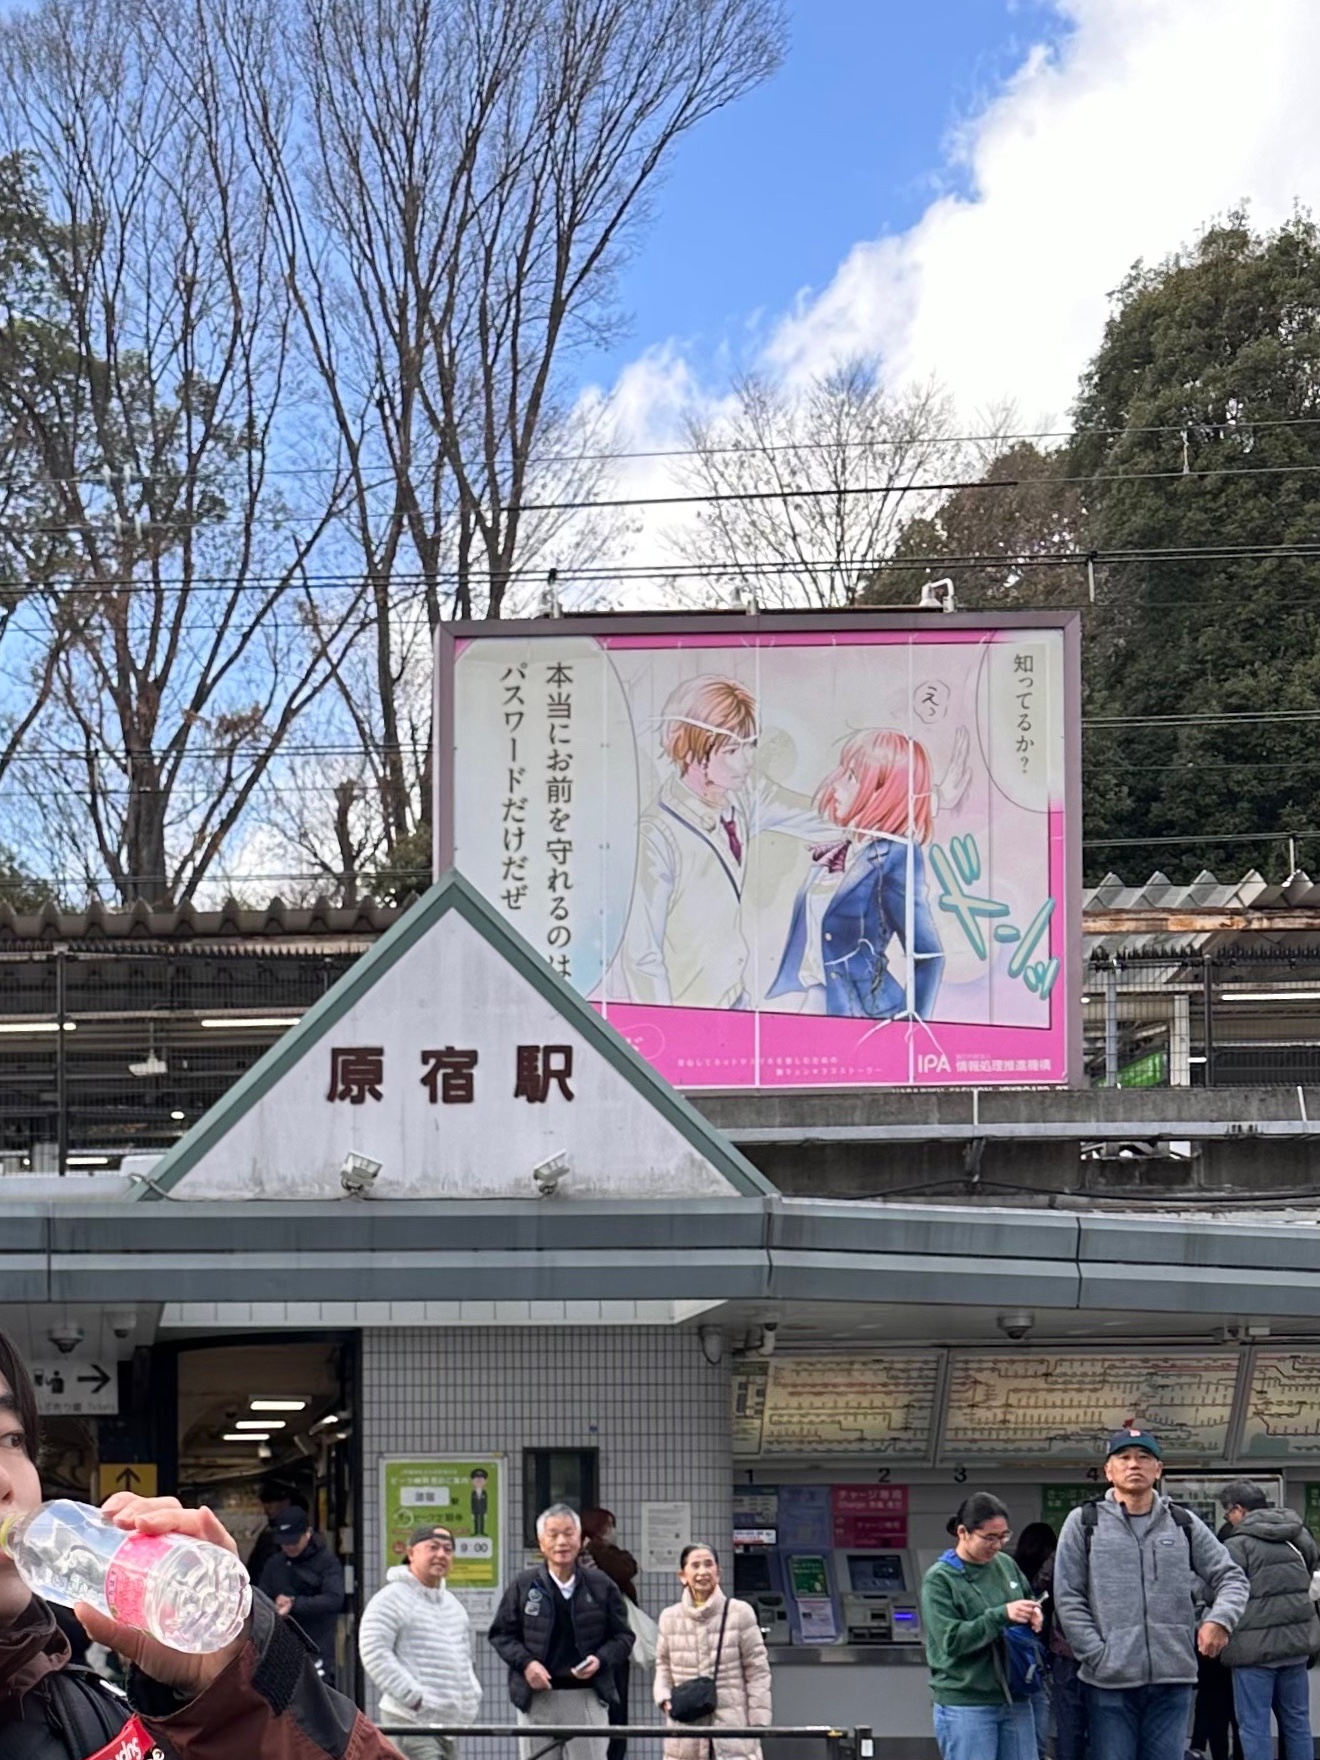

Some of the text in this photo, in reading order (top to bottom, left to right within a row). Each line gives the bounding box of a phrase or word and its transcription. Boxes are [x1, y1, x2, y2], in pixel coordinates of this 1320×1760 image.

[499, 661, 529, 911] パスワードだけだぜ
[917, 1053, 952, 1073] IPA
[326, 1044, 576, 1104] 原宿駅
[745, 1469, 754, 1484] 1
[879, 1467, 891, 1483] 2
[954, 1466, 967, 1483] 3
[1085, 1468, 1100, 1482] 4
